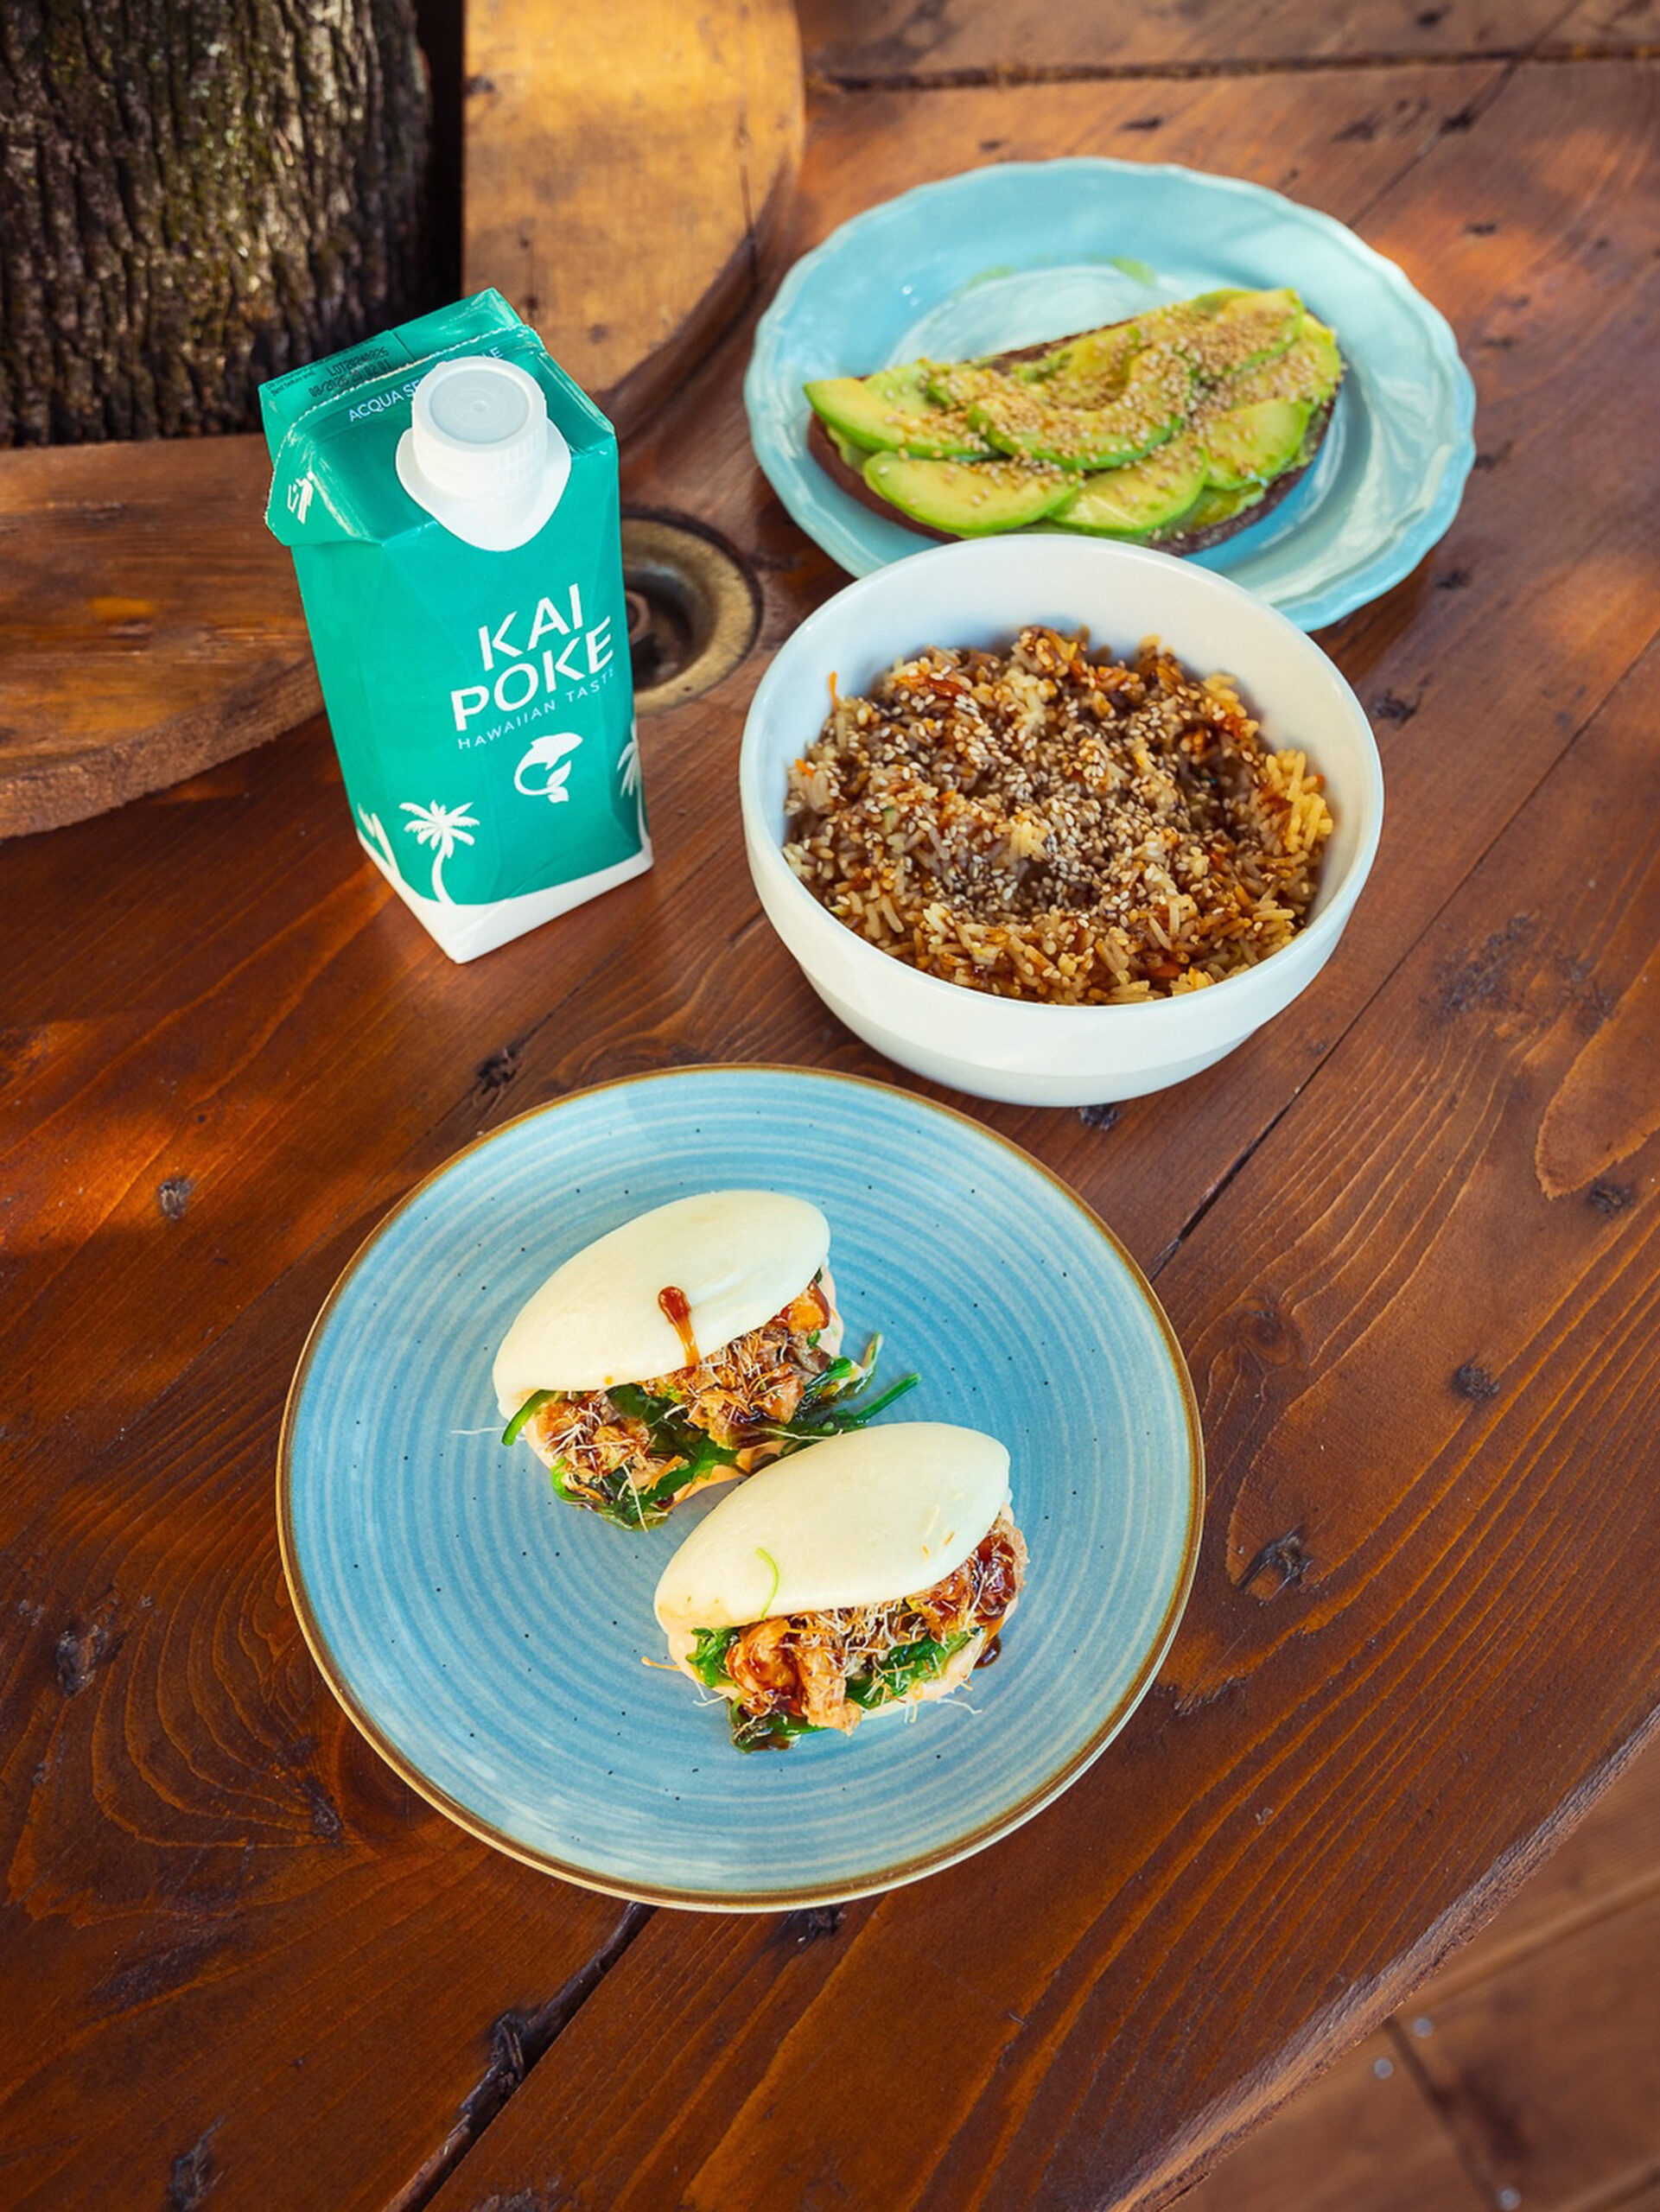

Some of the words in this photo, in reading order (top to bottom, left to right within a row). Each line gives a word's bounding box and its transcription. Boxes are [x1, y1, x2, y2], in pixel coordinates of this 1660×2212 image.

[348, 391, 404, 423] ACQUA
[478, 582, 583, 671] KAI
[450, 615, 614, 732] POKE
[457, 699, 556, 750] HAWAIIAN
